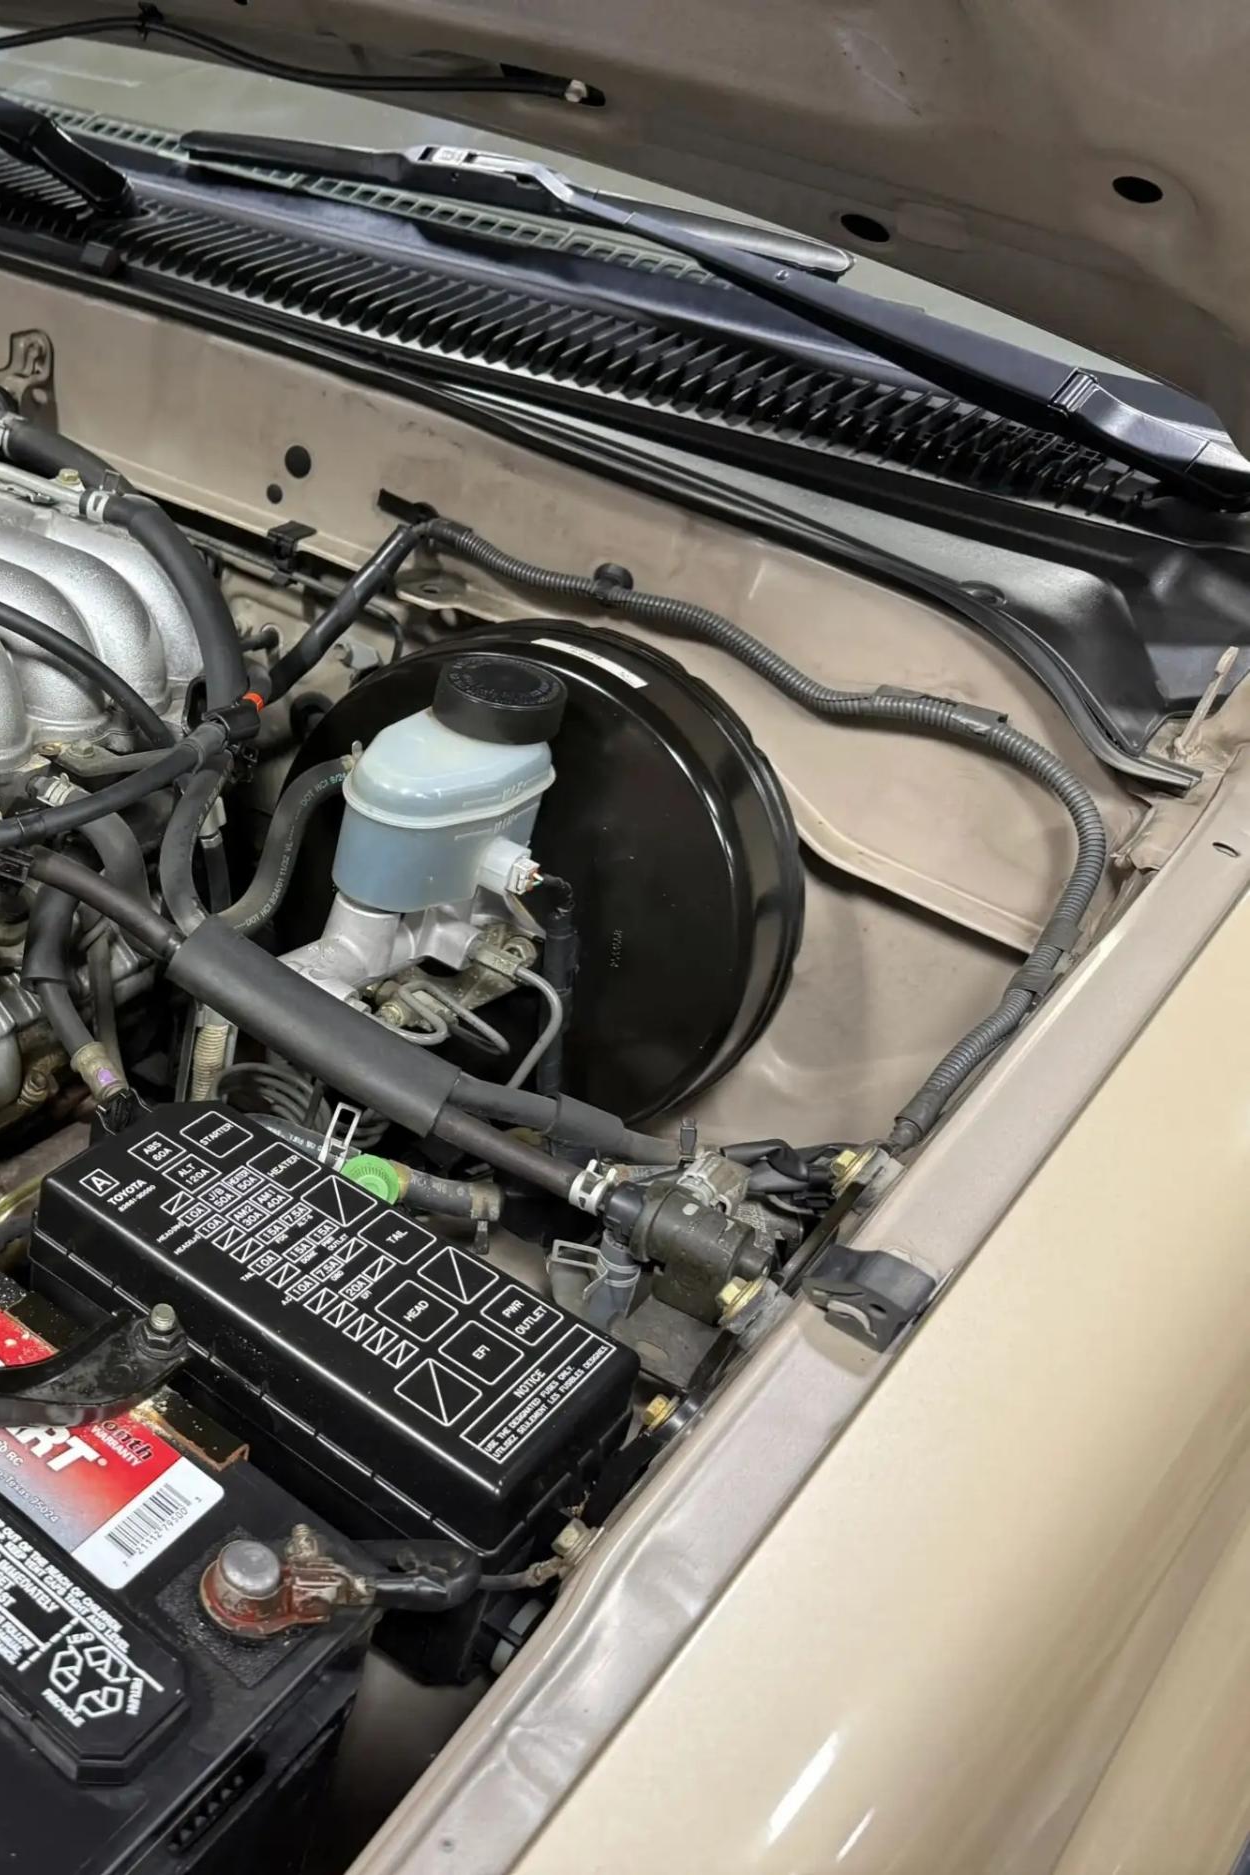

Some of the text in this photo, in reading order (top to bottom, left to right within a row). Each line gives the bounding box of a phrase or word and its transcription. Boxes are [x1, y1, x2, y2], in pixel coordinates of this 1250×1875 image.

[199, 1123, 233, 1145] STARTER
[143, 1141, 161, 1154] ABS
[152, 1148, 172, 1161] 60A
[177, 1163, 195, 1177] ALT
[267, 1155, 300, 1177] HEATER
[91, 1172, 112, 1192] A
[185, 1169, 209, 1185] 120A
[227, 1170, 249, 1185] HEATER
[237, 1176, 257, 1190] 50A
[107, 1179, 147, 1206] TOYOTA
[208, 1187, 224, 1200] J/B
[213, 1193, 234, 1207] 50A
[257, 1189, 275, 1203] AM1
[267, 1194, 285, 1208] 40A
[185, 1207, 204, 1220] 10A
[233, 1205, 254, 1221] AM2
[242, 1212, 262, 1226] 30A
[261, 1206, 306, 1238] 15A 7.5A
[202, 1219, 222, 1232] 10A
[287, 1225, 333, 1257] 15A 15A
[327, 1233, 348, 1250] OUTLET
[386, 1230, 408, 1243] TAIL
[240, 1255, 276, 1281] TAIL 10A
[293, 1261, 341, 1295] 10A 7.5A
[345, 1280, 368, 1296] 20A
[403, 1300, 429, 1323] HEAD
[501, 1299, 525, 1319] PWR
[514, 1305, 548, 1336] OUTLET
[472, 1344, 491, 1360] EFI
[514, 1371, 544, 1399] NOTICE
[484, 1439, 498, 1452] USE
[497, 1427, 511, 1438] THE
[508, 1398, 540, 1428] DESIGNATED
[540, 1380, 559, 1397] FUSES
[492, 1369, 584, 1457] UTILISEZ SEULEMENT LES FUSIBLES
[89, 1425, 143, 1467] WARRANTY
[100, 1419, 153, 1460] onth
[7, 1451, 23, 1466] RC
[6, 1476, 30, 1498] Texas
[29, 1496, 59, 1523] 75024
[2, 1527, 22, 1543] OUT
[17, 1541, 33, 1554] OF
[30, 1551, 48, 1567] THE
[44, 1565, 73, 1590] REACH
[70, 1586, 85, 1601] OF
[24, 1557, 46, 1576] VENT
[44, 1575, 66, 1595] CAPS
[65, 1592, 90, 1615] TIGHT
[86, 1613, 107, 1630] AND
[65, 1631, 95, 1645] LEAD
[126, 1677, 144, 1716] RETURN
[41, 1688, 86, 1728] RECYCLE
